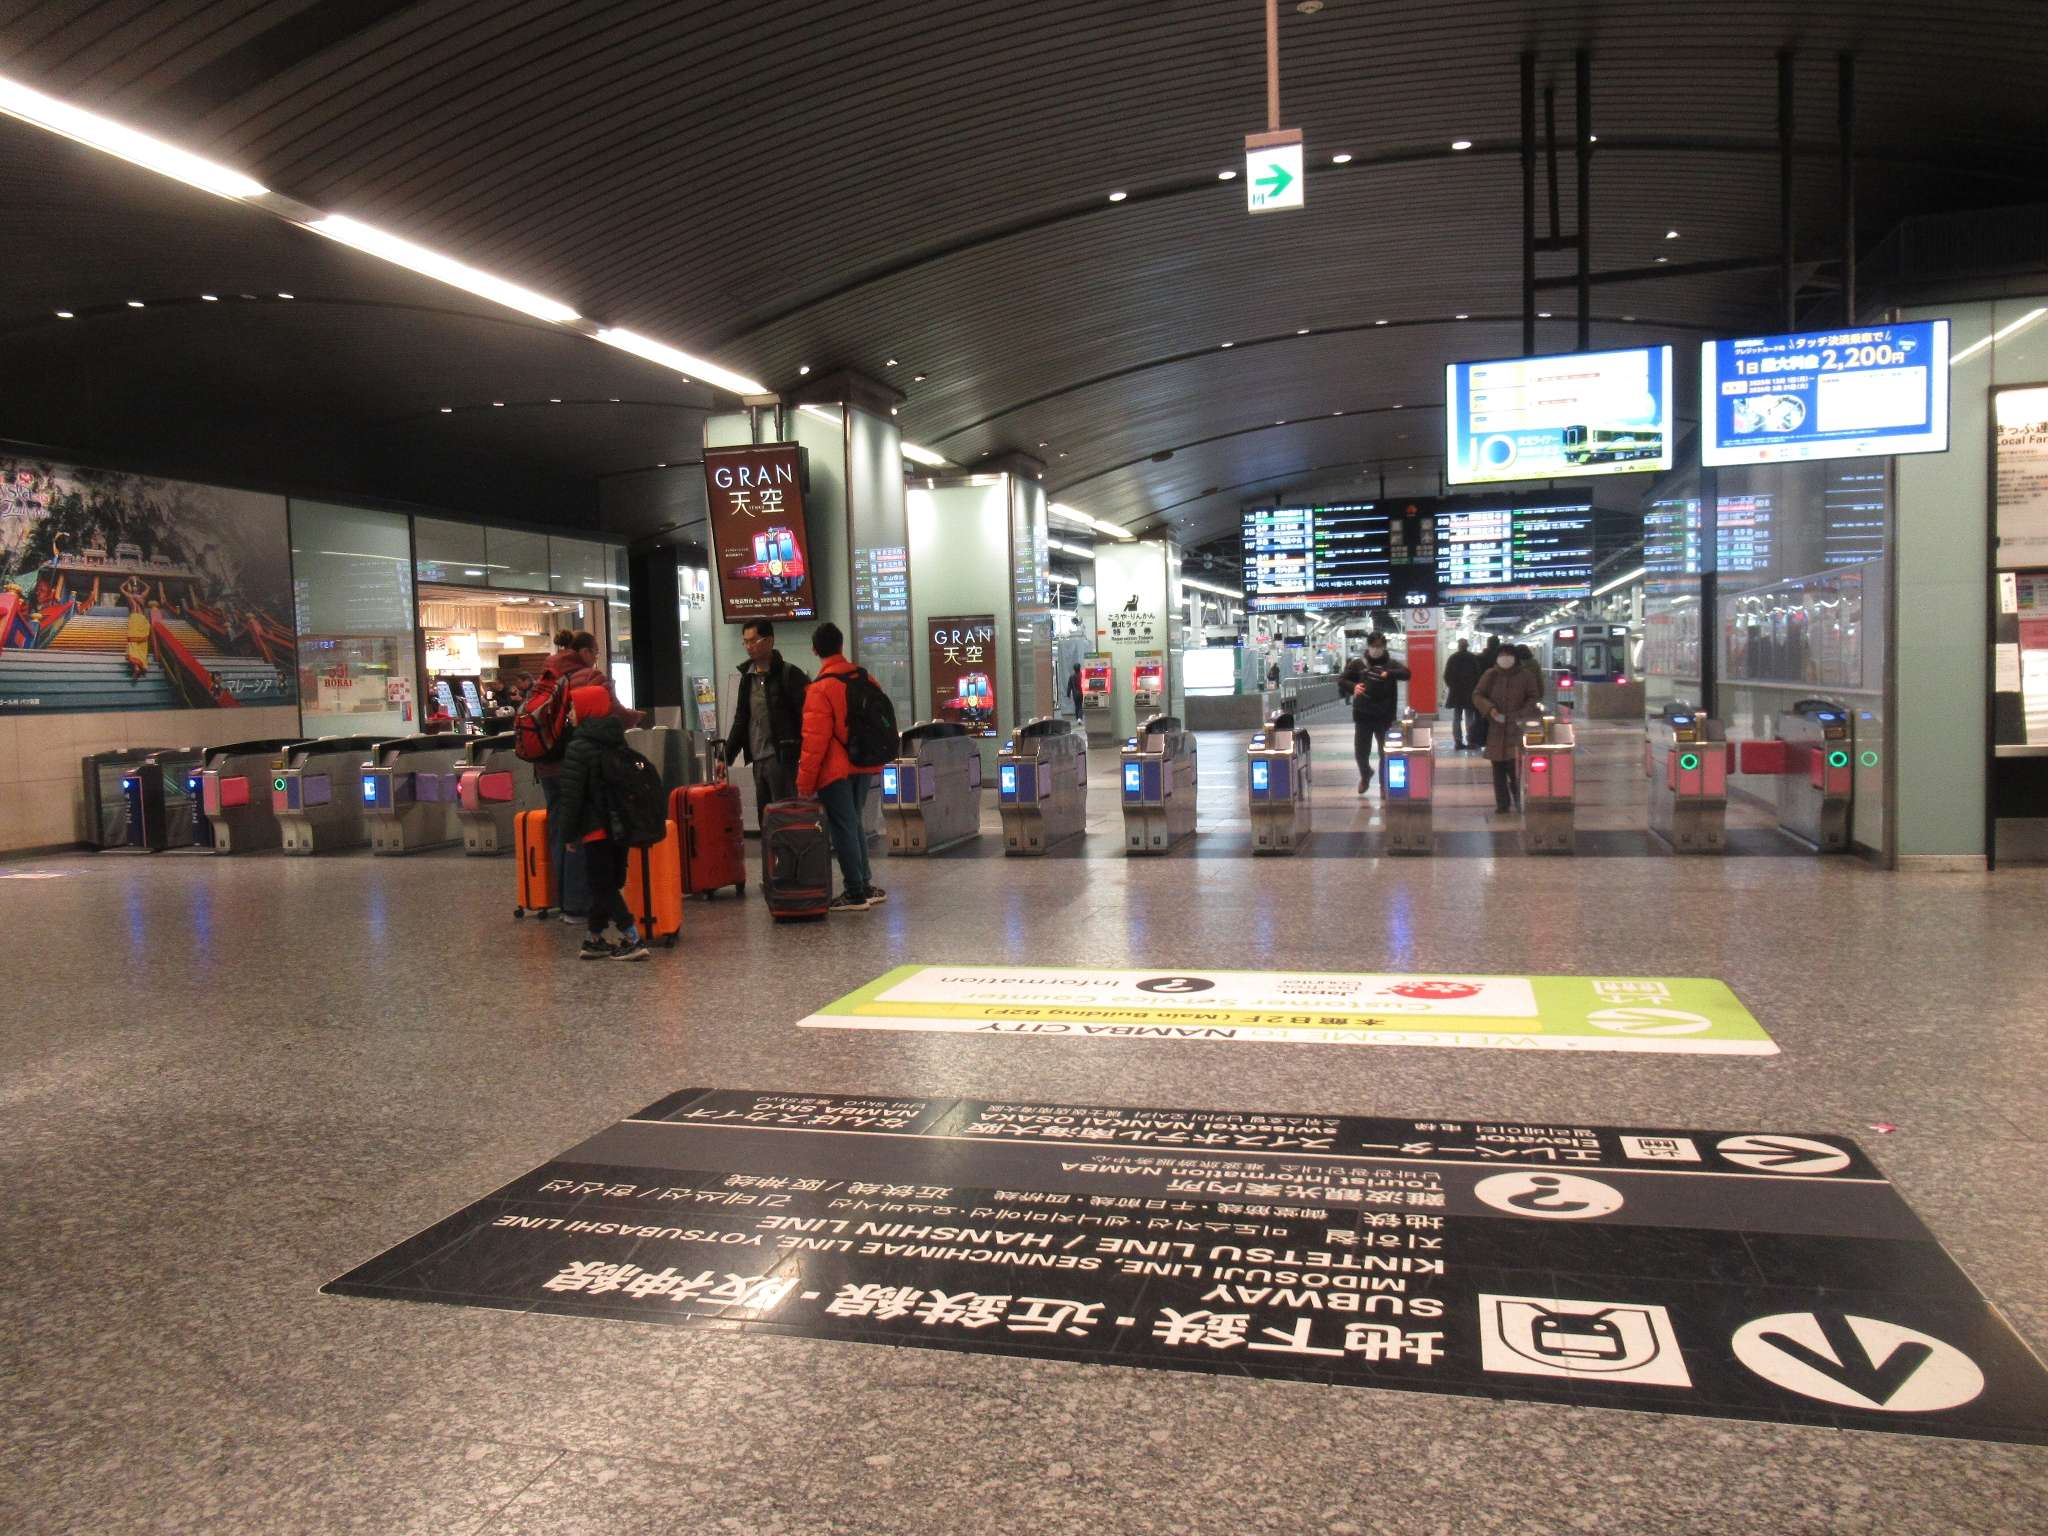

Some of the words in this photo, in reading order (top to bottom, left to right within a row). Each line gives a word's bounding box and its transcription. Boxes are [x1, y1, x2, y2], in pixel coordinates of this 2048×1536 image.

[1822, 345, 1905, 370] 2,200円
[715, 463, 792, 488] GRAN
[728, 488, 785, 518] 天空
[934, 629, 990, 645] GRAN
[944, 646, 983, 666] 天空
[933, 976, 1122, 987] Information
[1044, 1009, 1151, 1018] Building
[974, 1021, 1073, 1033] CITY
[1075, 1024, 1238, 1038] NAMBA
[747, 1102, 821, 1112] SkyO
[817, 1105, 922, 1117] NAMBA
[675, 1107, 913, 1129] なんばスカイオ
[973, 1112, 1077, 1124] OSAKA
[1079, 1117, 1196, 1129] NANKAI
[961, 1121, 1335, 1149] スイスホテル南海大阪
[1474, 1133, 1600, 1147] Elevator
[1360, 1138, 1604, 1162] エレベーター
[1055, 1161, 1164, 1175] NAMBA
[1168, 1167, 1331, 1185] Information
[532, 1178, 646, 1197] 한신선
[1163, 1178, 1445, 1206] 難波観光案内所
[1337, 1176, 1444, 1191] Tourist
[488, 1214, 568, 1229] LINE
[753, 1214, 851, 1232] LINE
[1360, 1211, 1444, 1231] 地铁
[559, 1219, 771, 1245] YOTSUBASHI
[852, 1221, 1055, 1246] HANSHIN
[1322, 1227, 1443, 1251] 지하철
[765, 1233, 858, 1251] LINE,
[1093, 1236, 1197, 1257] LINE
[855, 1240, 1105, 1270] SENNICHIMAE
[1207, 1244, 1445, 1274] KINTETSU
[1109, 1256, 1205, 1277] LINE,
[1199, 1281, 1444, 1317] SUBWAY
